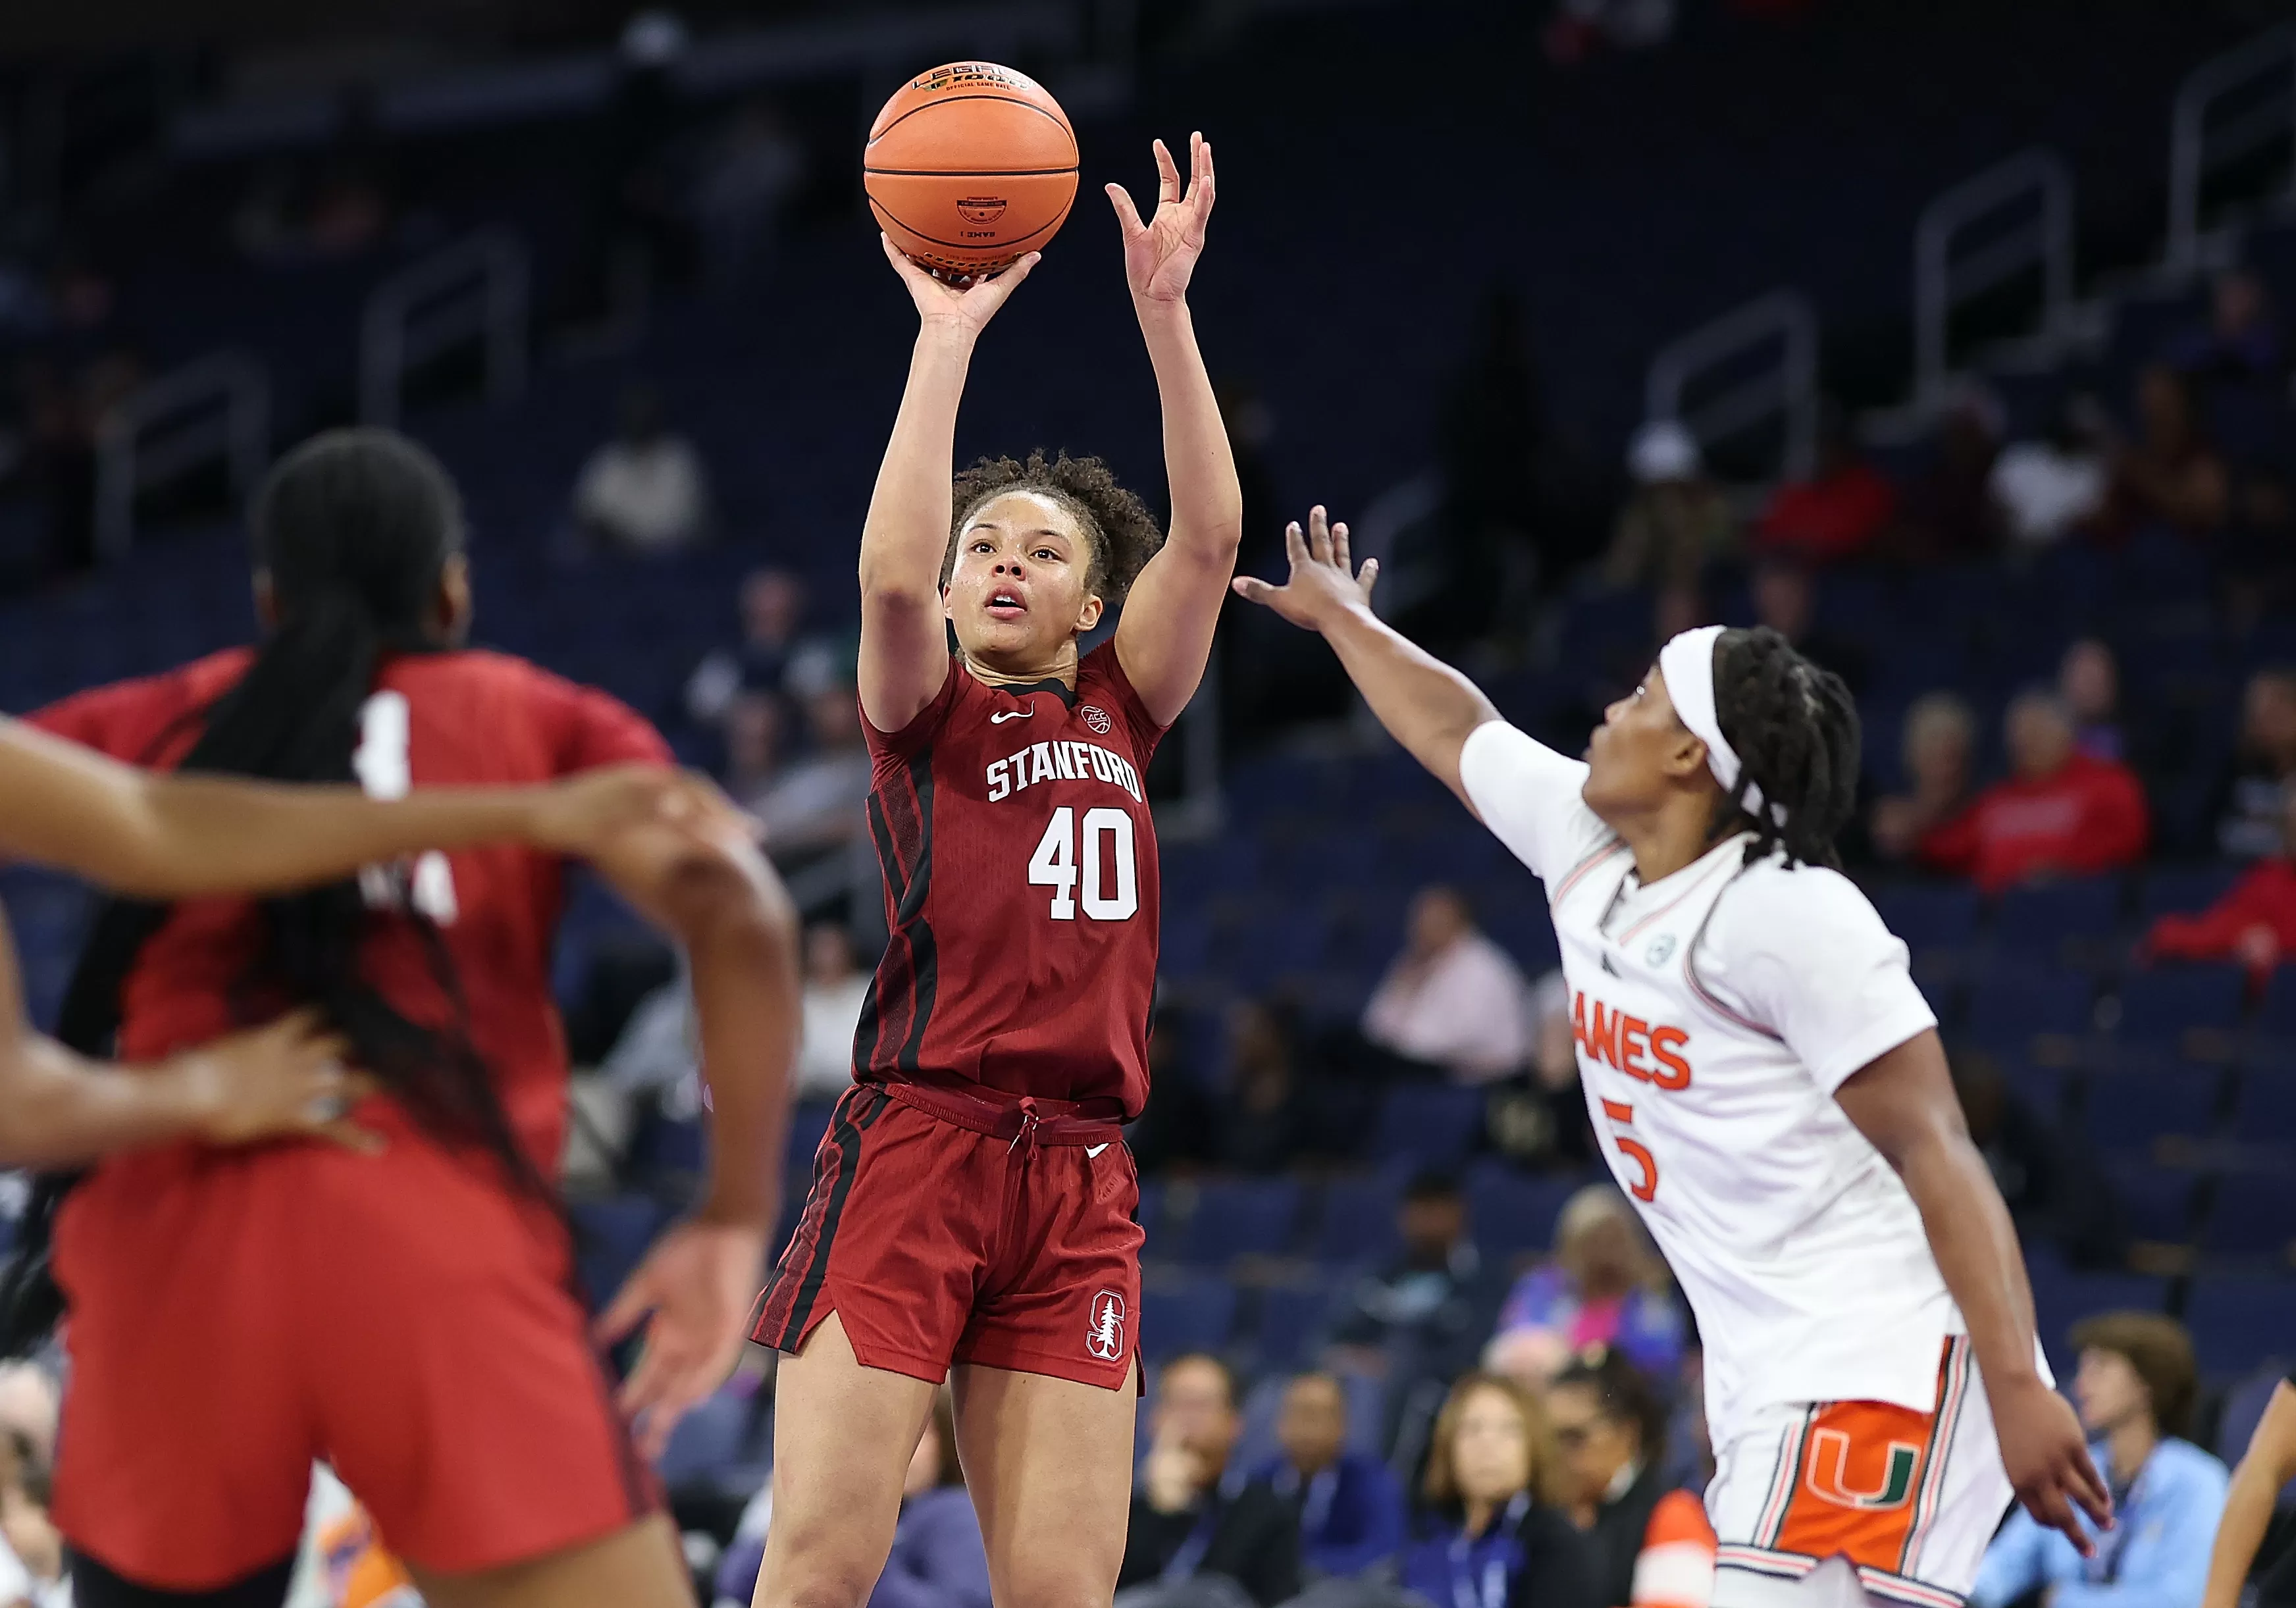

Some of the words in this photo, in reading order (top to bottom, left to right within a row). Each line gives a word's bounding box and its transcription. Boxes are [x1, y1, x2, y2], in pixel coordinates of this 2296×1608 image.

[946, 82, 974, 91] OFFICIAL
[1087, 712, 1107, 721] ACC
[987, 740, 1143, 804] STANFORD
[1028, 806, 1138, 920] 40
[1602, 1097, 1657, 1202] 5
[1807, 1428, 1920, 1511] U
